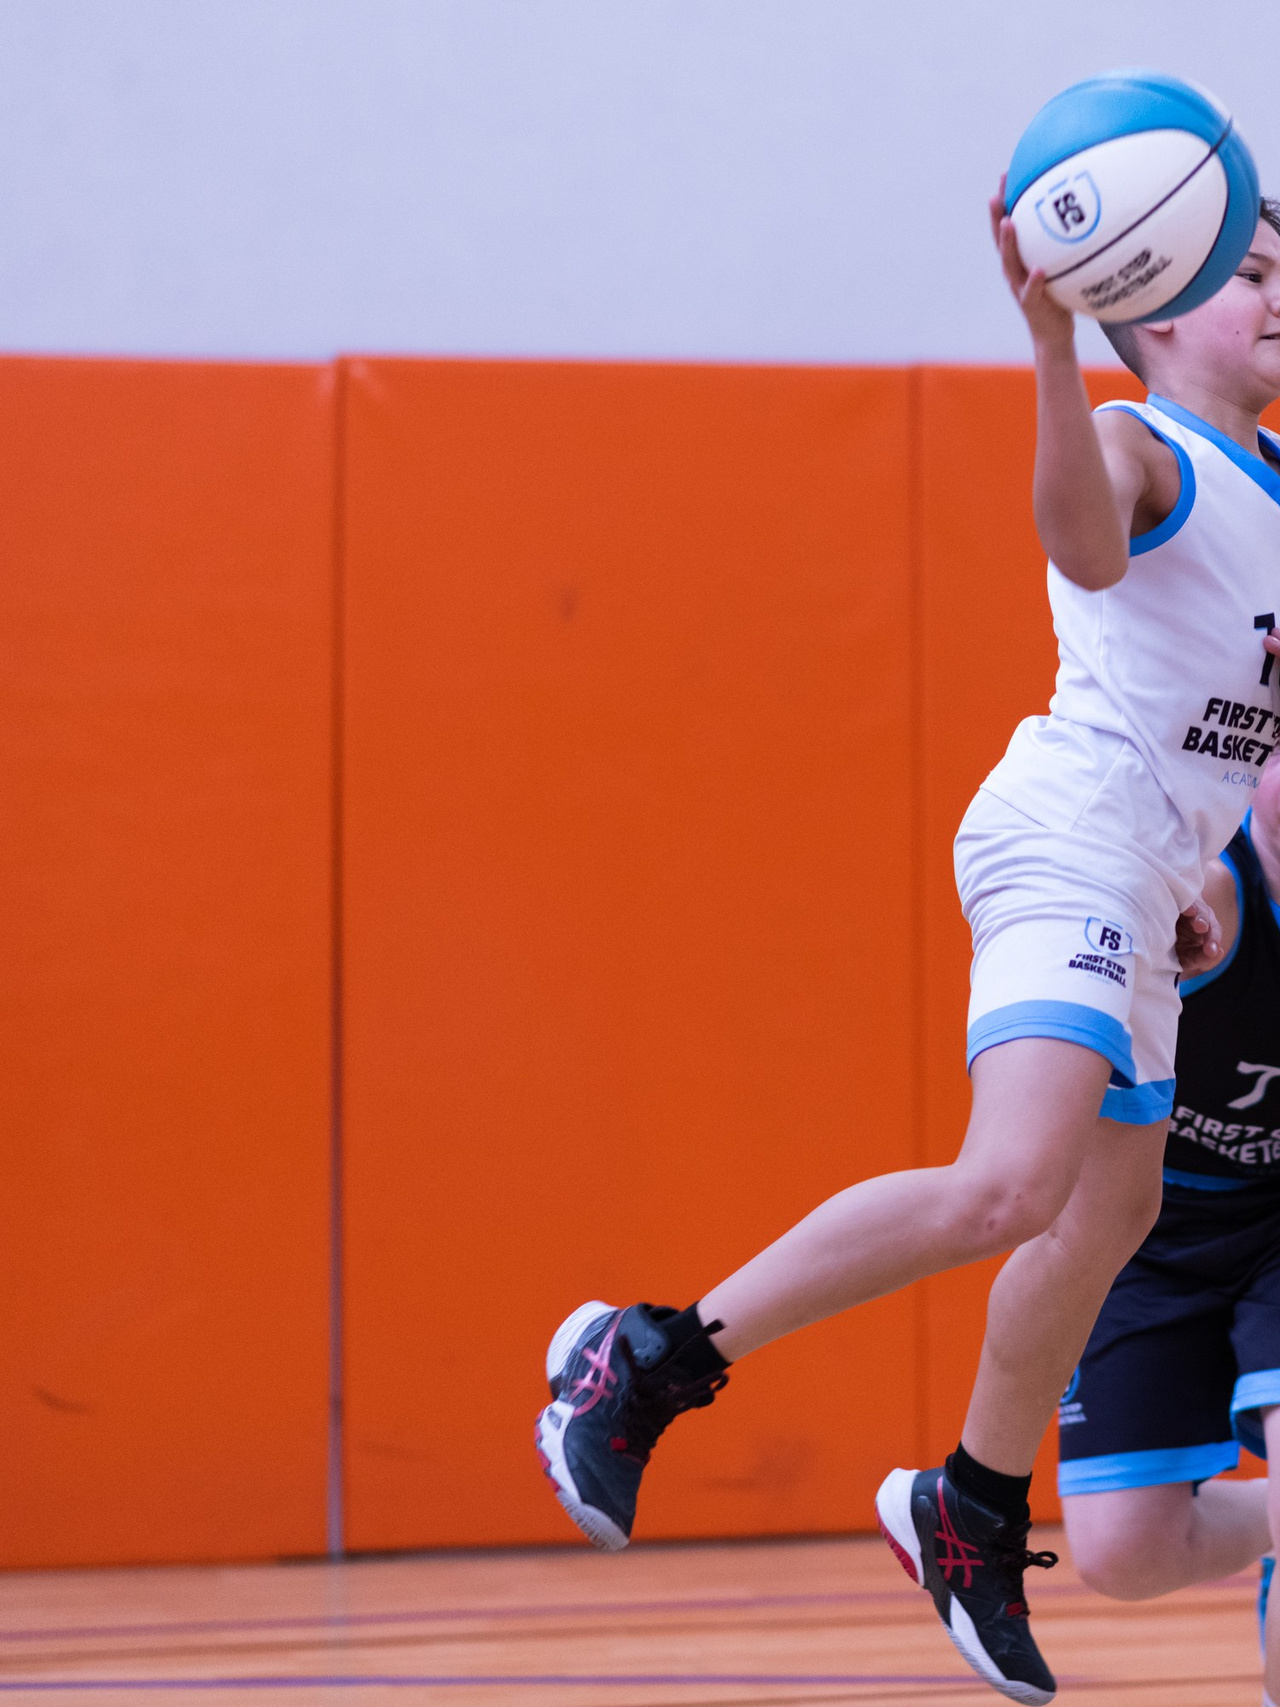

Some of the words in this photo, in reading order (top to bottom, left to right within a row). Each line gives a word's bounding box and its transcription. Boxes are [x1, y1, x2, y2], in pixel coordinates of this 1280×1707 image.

[1053, 191, 1086, 234] FS
[1202, 697, 1274, 734] FIRST
[1181, 726, 1275, 767] BASKET
[1099, 926, 1121, 951] FS
[1068, 959, 1127, 988] BASKETBALL
[1174, 1105, 1265, 1141] FIRST
